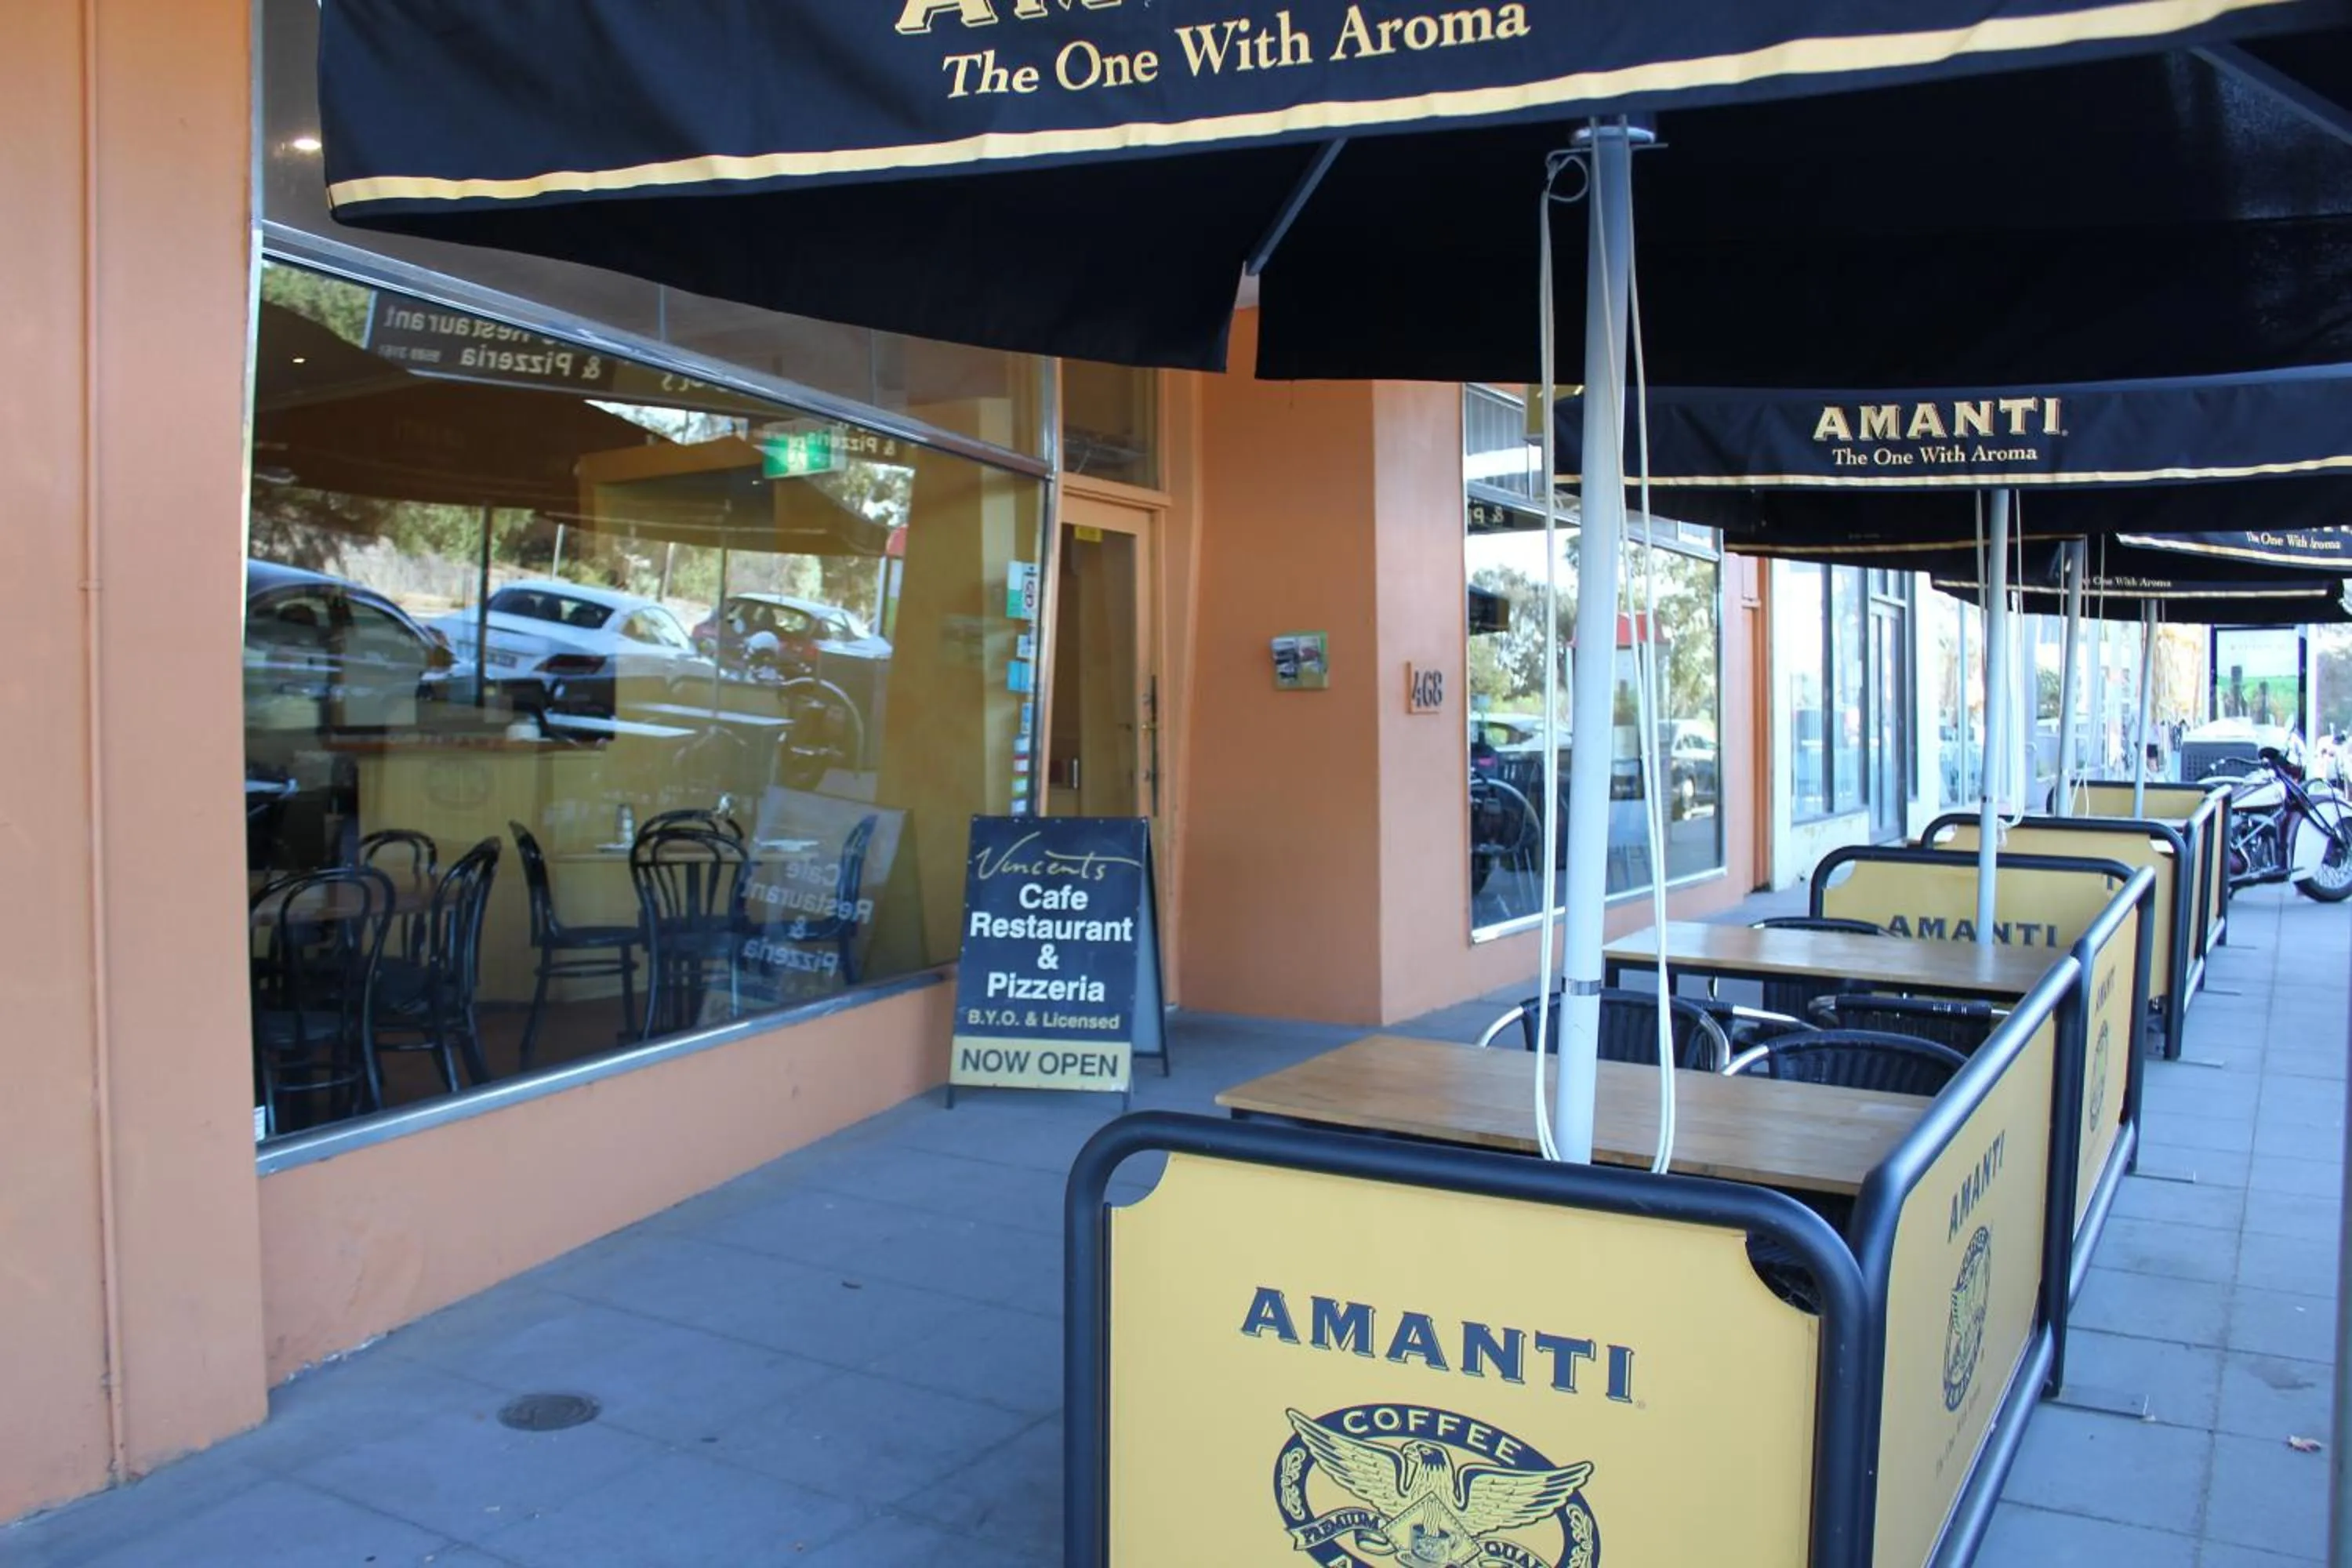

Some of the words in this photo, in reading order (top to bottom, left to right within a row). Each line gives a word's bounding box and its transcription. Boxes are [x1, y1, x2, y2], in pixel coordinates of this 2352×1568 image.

[942, 54, 1039, 99] The
[1055, 40, 1159, 91] One
[1175, 15, 1313, 76] With
[1330, 2, 1531, 62] Aroma
[1813, 397, 2062, 442] AMANTI
[1833, 448, 1867, 466] The
[1873, 448, 1913, 465] One
[1919, 445, 1965, 463] With
[1971, 445, 2038, 463] Aroma
[2260, 532, 2284, 546] One
[2286, 532, 2308, 548] With
[1412, 669, 1443, 708] 468
[1019, 883, 1088, 910] Cafe
[969, 912, 1133, 942] Restaurant
[1037, 943, 1059, 970] &
[986, 972, 1105, 1002] Pizzeria
[967, 1008, 1019, 1026] B.Y.O.
[1025, 1012, 1037, 1027] &
[1043, 1012, 1120, 1030] Licensed
[960, 1047, 1030, 1073] NOW
[1038, 1051, 1118, 1078] OPEN
[1240, 1286, 1635, 1404] AMANTI
[1342, 1406, 1522, 1465] COFFEE
